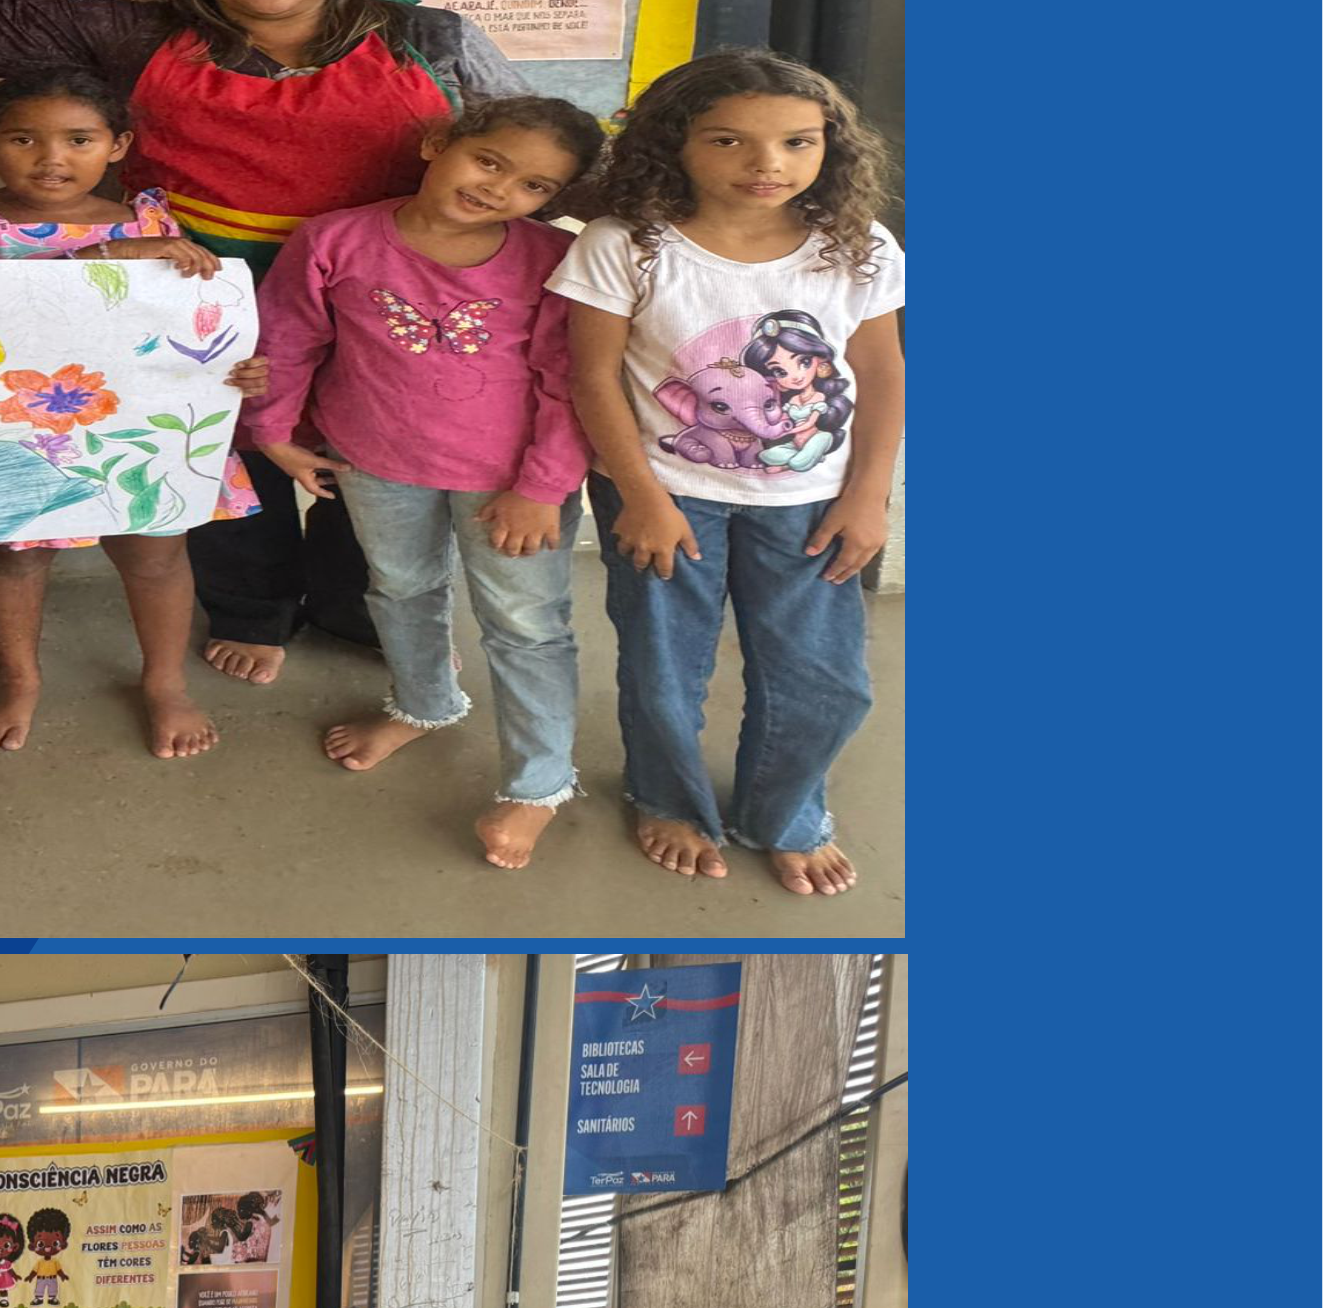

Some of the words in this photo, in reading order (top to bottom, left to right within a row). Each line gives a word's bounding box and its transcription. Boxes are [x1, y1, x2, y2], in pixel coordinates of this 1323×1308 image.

[582, 1040, 645, 1058] BIBLIOTECAS
[131, 1057, 193, 1072] GOVERNO
[199, 1056, 218, 1067] DO
[581, 1063, 605, 1079] SALA
[606, 1063, 619, 1077] DE
[580, 1079, 640, 1096] TECNOLOGIA
[577, 1115, 635, 1134] SANITÁRIOS
[105, 1160, 166, 1186] NEGRA
[86, 1225, 117, 1234] ASSIM
[119, 1224, 146, 1233] COMO
[149, 1223, 162, 1232] AS
[81, 1242, 118, 1251] FLORES
[121, 1240, 166, 1250] PESSOAS
[97, 1256, 117, 1268] TÊM
[119, 1257, 151, 1267] CORES
[96, 1274, 155, 1284] DIFERENTES
